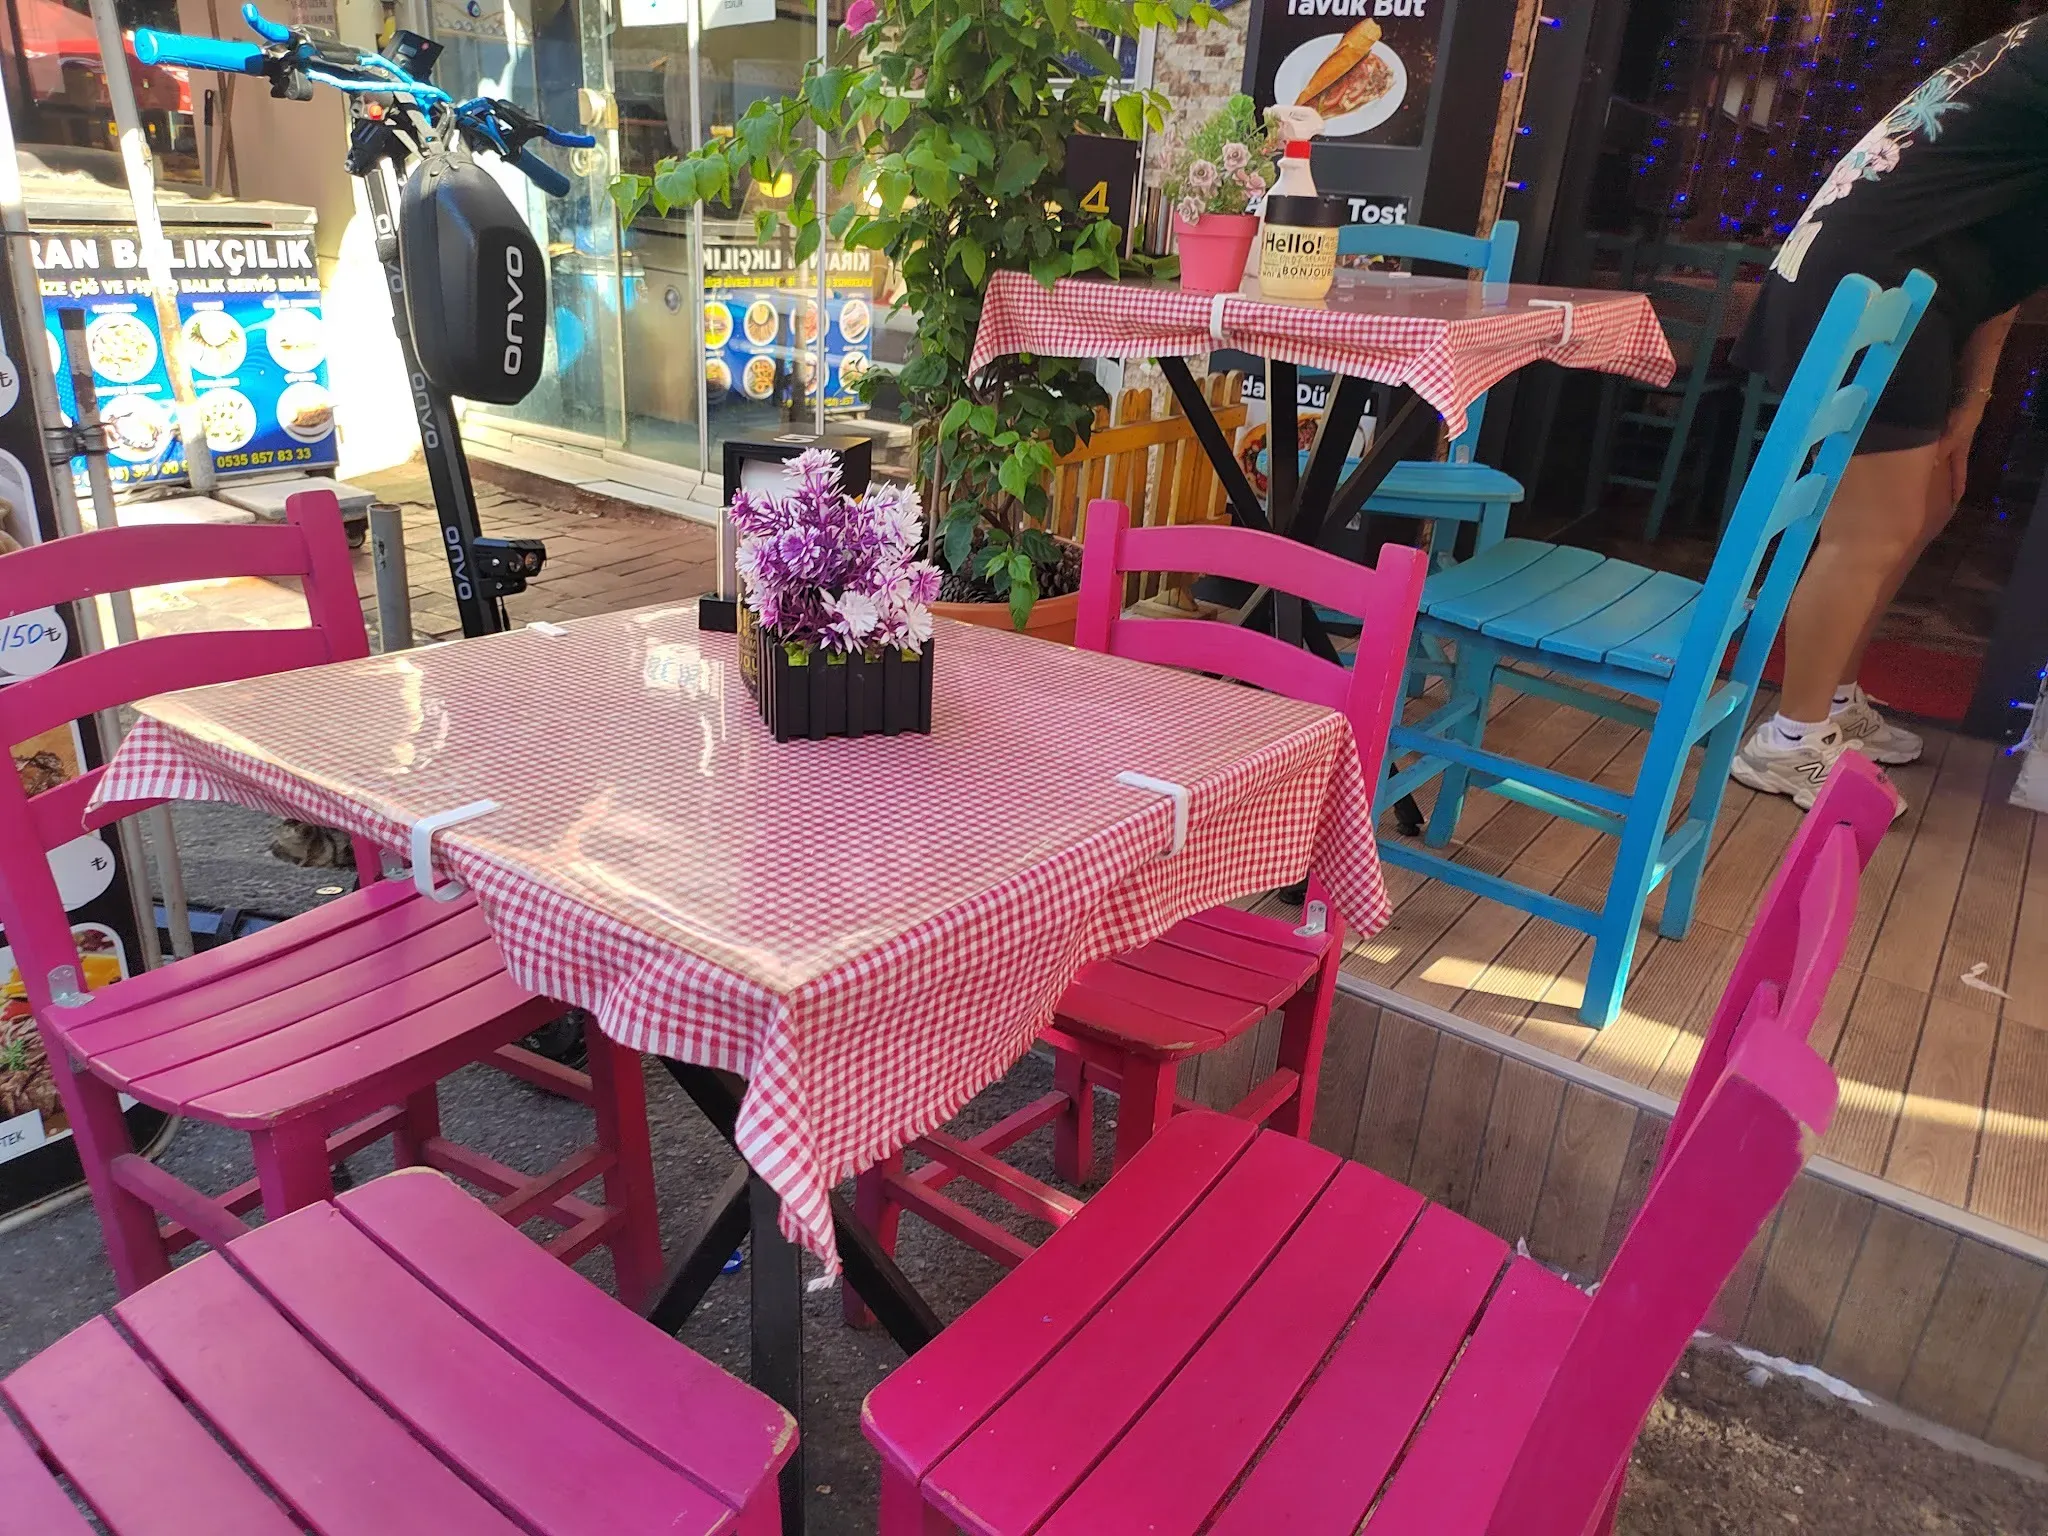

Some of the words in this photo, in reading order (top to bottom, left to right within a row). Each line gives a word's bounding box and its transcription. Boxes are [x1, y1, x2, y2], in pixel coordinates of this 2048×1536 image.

[1288, 0, 1366, 16] Tavuk
[1373, 0, 1426, 17] But
[1080, 181, 1110, 213] 4
[1347, 198, 1407, 226] Tost
[1265, 232, 1321, 255] Hello!
[217, 456, 249, 469] 0535
[251, 453, 274, 466] 857
[277, 450, 295, 463] 83
[297, 448, 312, 460] 33
